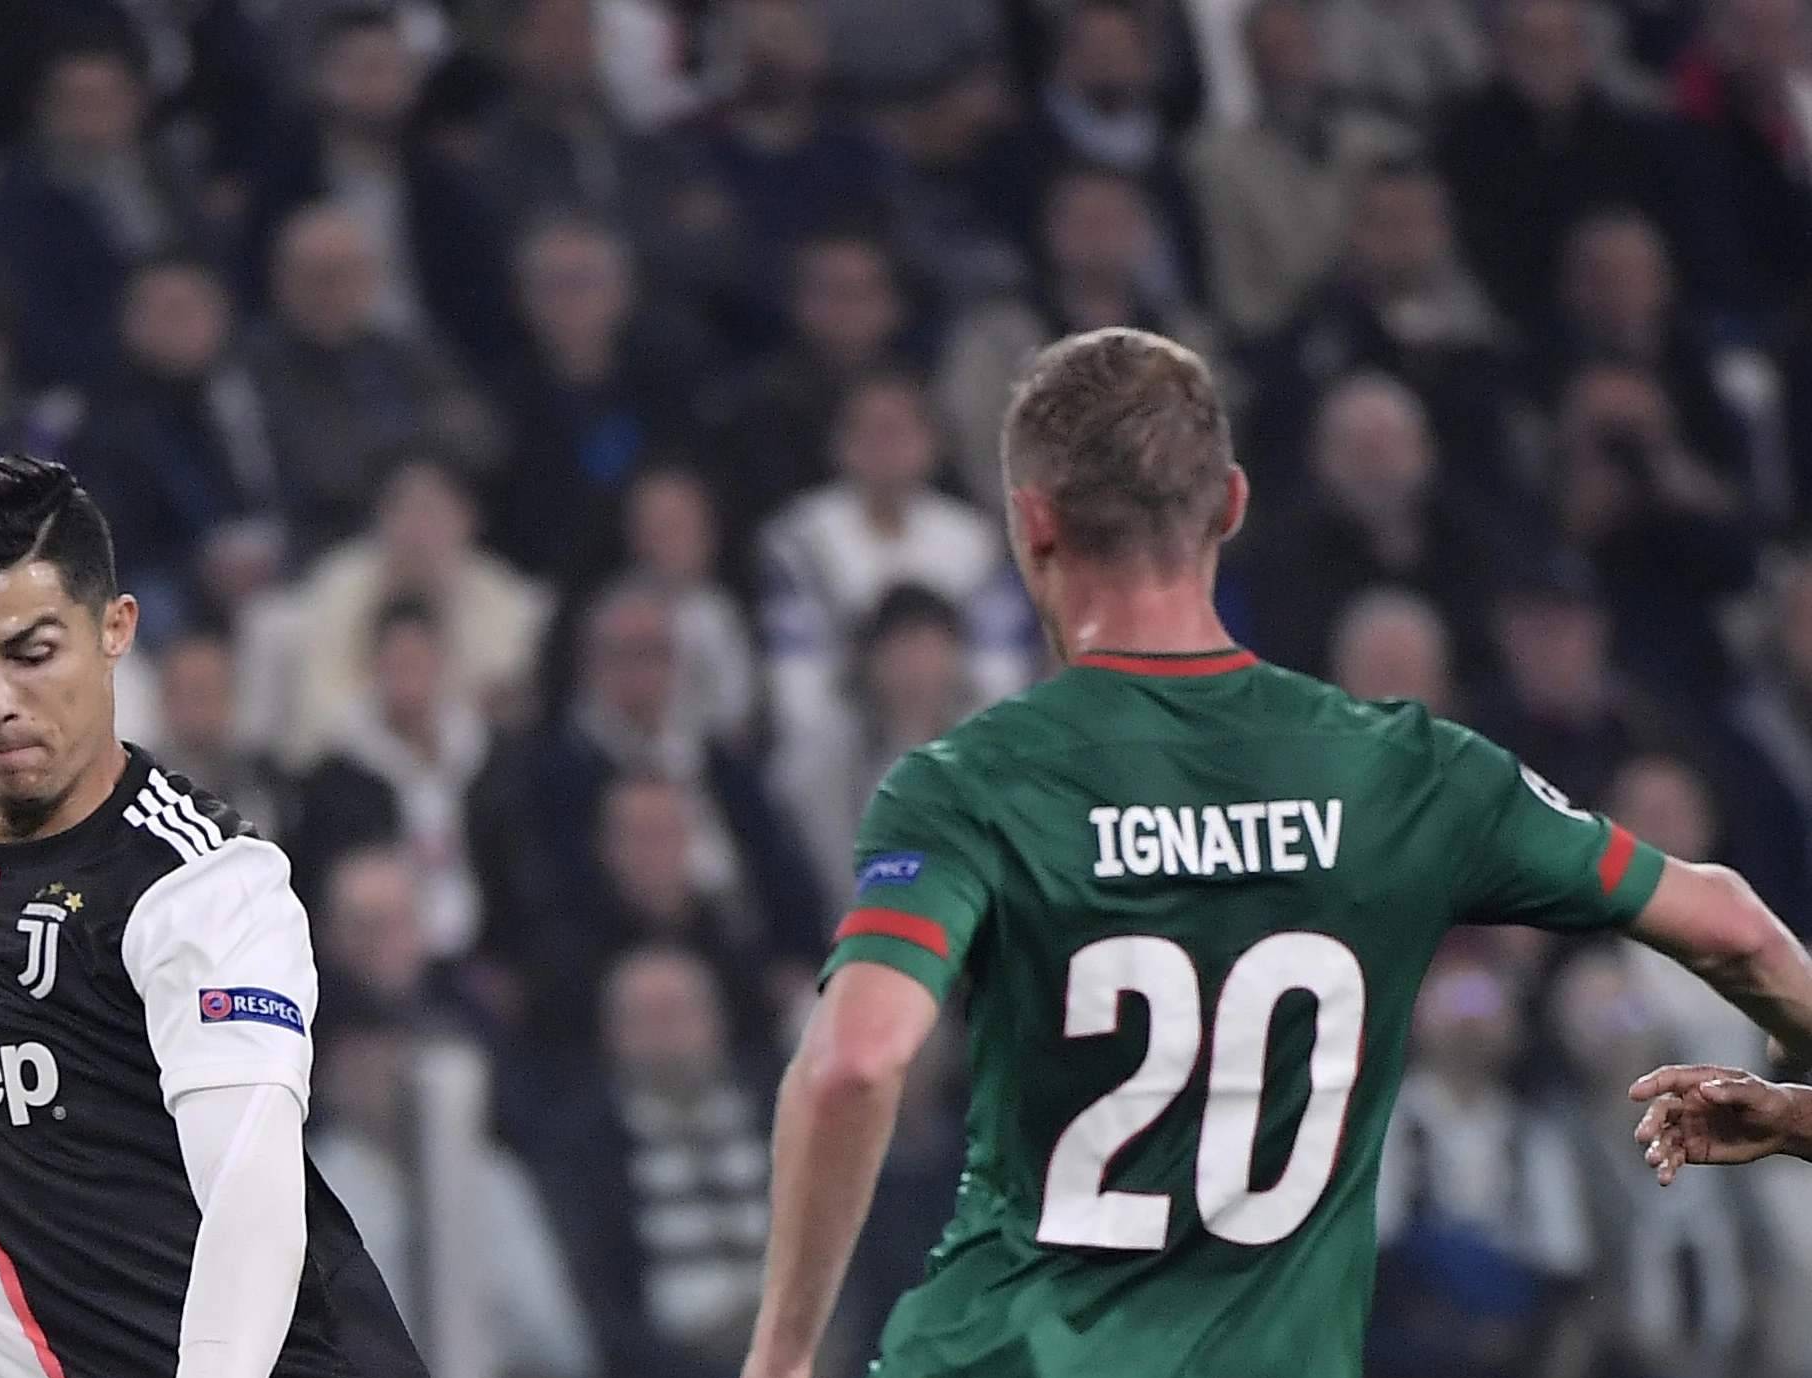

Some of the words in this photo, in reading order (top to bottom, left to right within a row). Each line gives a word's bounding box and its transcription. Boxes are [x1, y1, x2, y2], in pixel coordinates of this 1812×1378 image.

[1088, 798, 1344, 878] IGNATEV
[233, 995, 303, 1027] RESPECT
[1034, 930, 1366, 1251] 20
